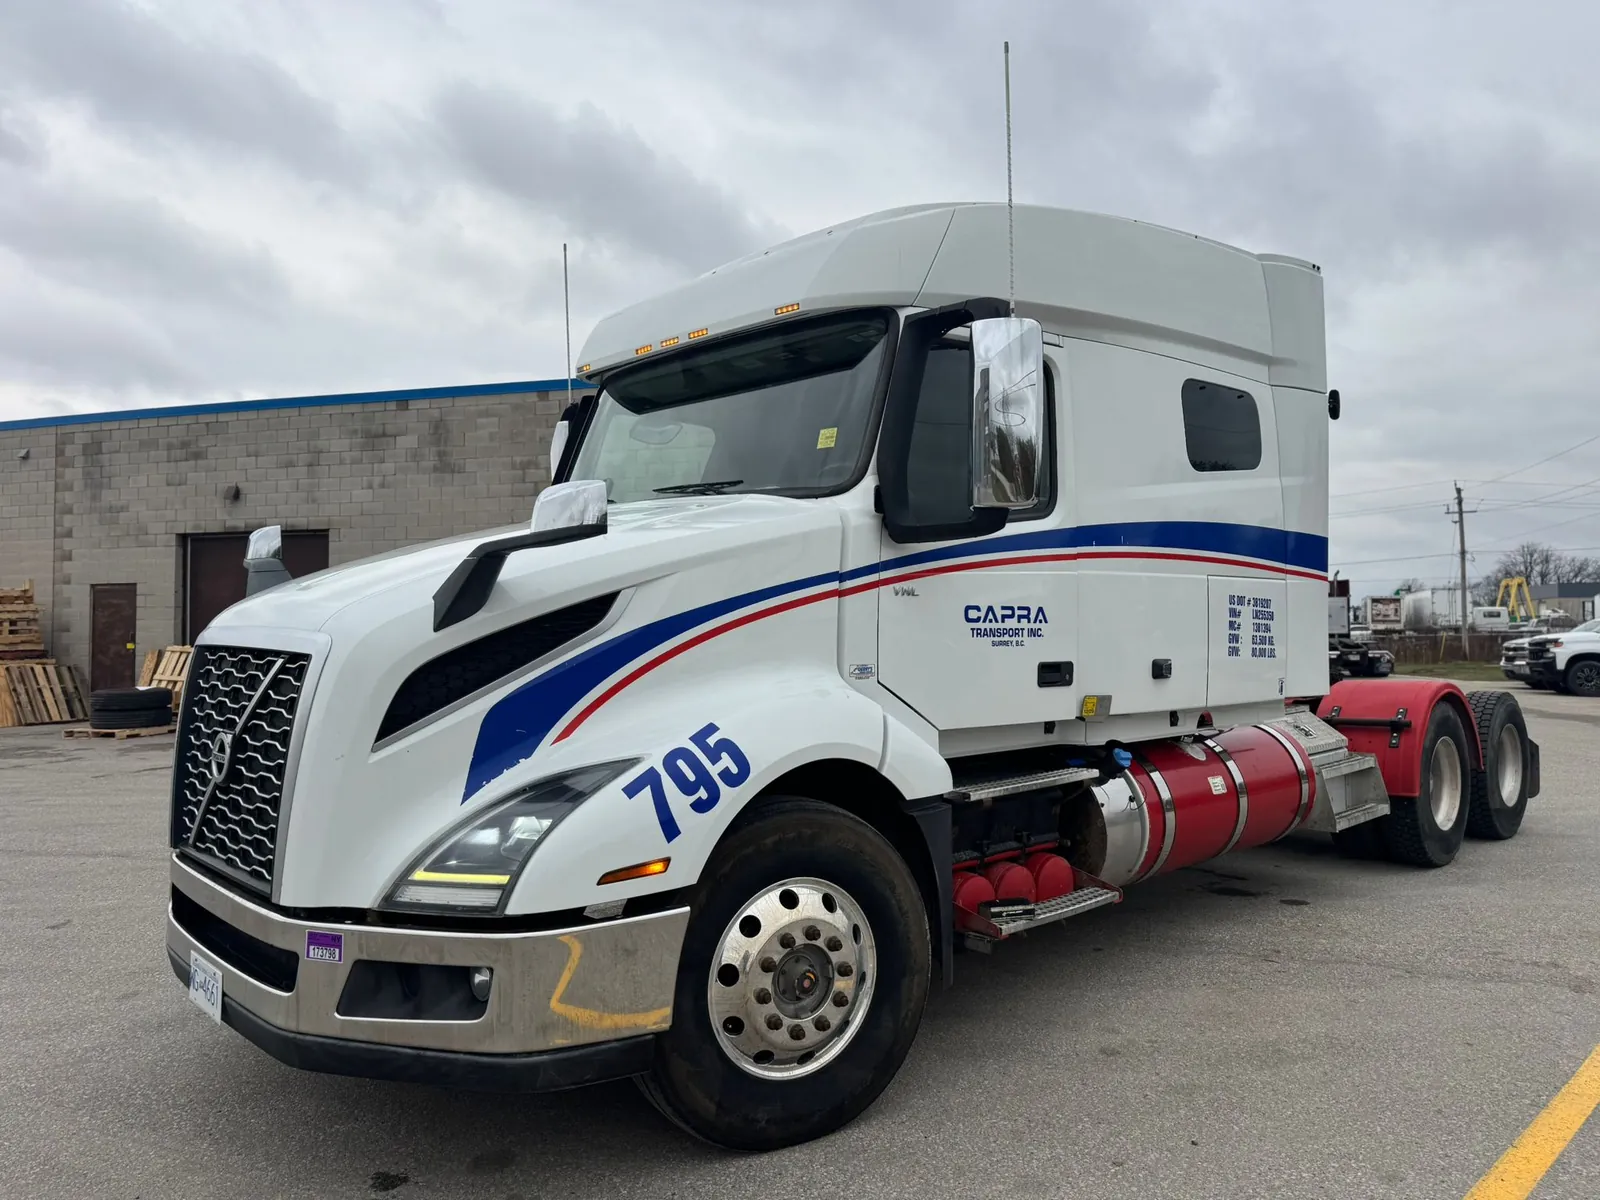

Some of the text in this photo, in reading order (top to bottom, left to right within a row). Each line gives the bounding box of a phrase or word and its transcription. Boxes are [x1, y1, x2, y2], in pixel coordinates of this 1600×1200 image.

[1229, 594, 1236, 605] US
[1236, 595, 1246, 606] DOT
[1247, 598, 1252, 607] #
[964, 605, 1048, 624] CAPRA
[1228, 607, 1242, 618] VIN#
[1228, 620, 1241, 631] MC#
[970, 628, 1044, 638] TRANSPORT INC.
[1228, 633, 1239, 644] GVW
[1228, 645, 1240, 657] GVW:
[622, 722, 751, 844] 795
[312, 947, 337, 959] 173798
